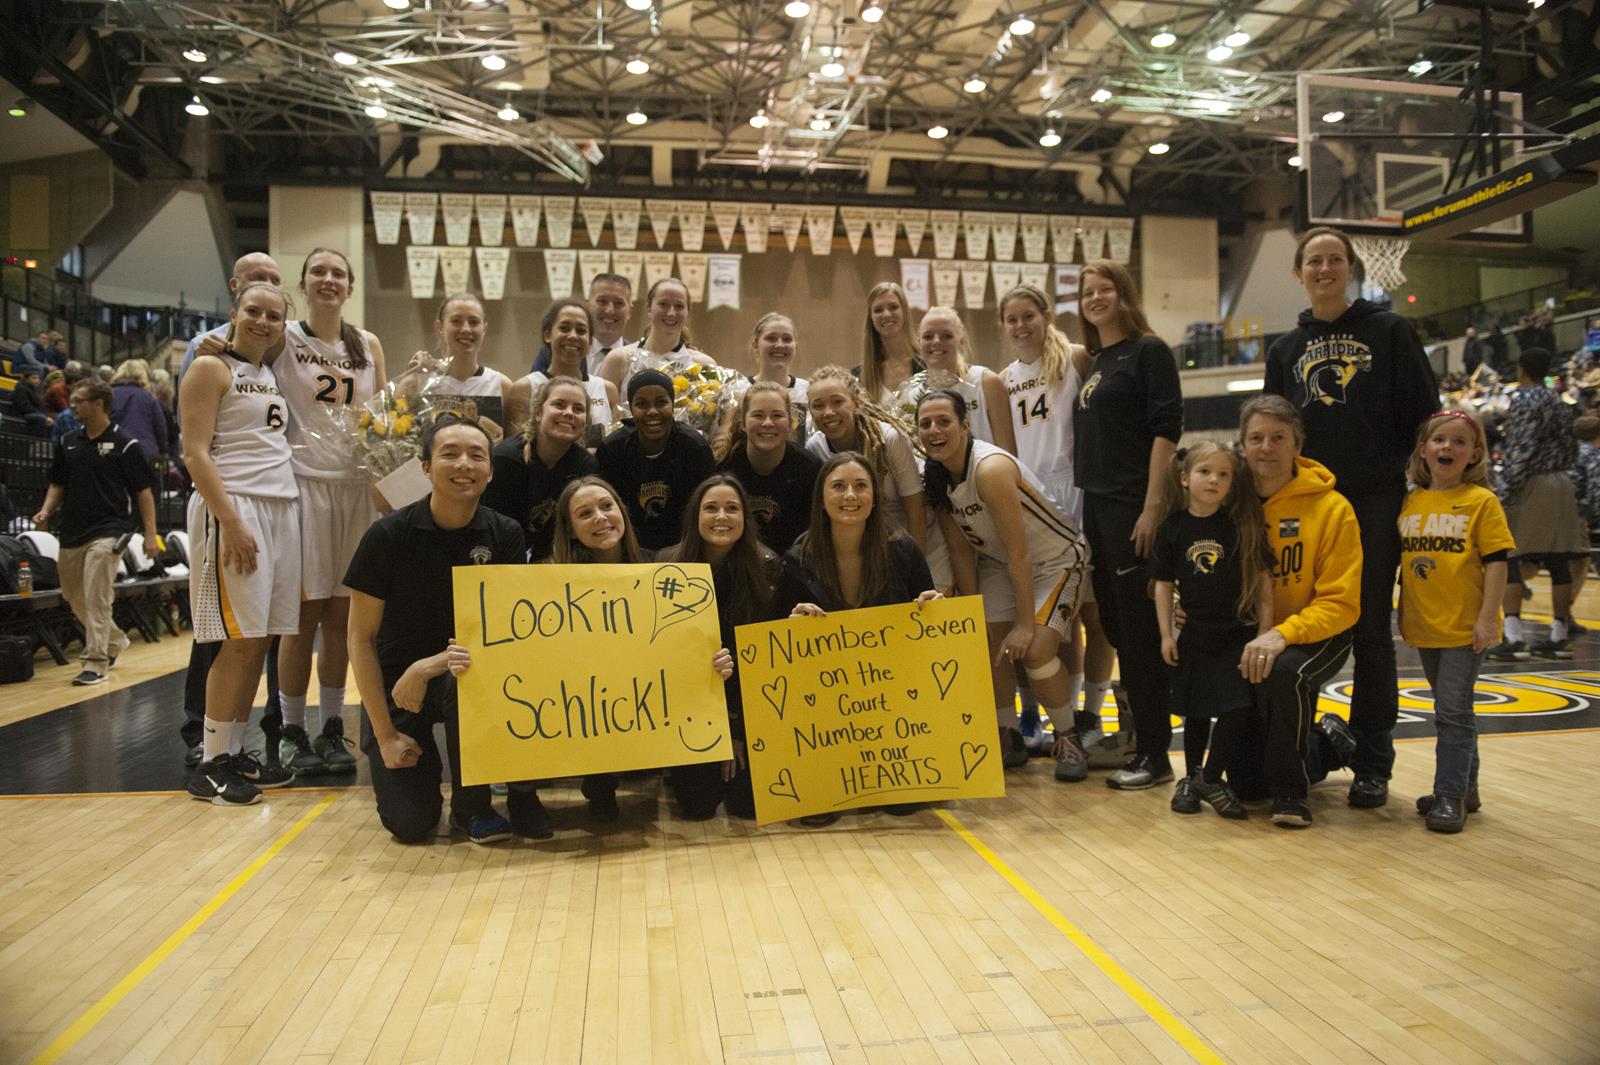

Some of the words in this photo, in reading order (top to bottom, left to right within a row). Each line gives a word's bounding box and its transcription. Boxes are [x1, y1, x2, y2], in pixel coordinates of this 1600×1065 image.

[1404, 172, 1534, 229] www.forumathletic.ca
[295, 353, 369, 371] WARIOR
[315, 374, 355, 405] 21
[266, 403, 284, 429] 6
[1017, 392, 1049, 426] 14
[1422, 513, 1471, 538] ARE
[1401, 535, 1466, 553] ARRIORS
[479, 578, 641, 647] Lookin'
[768, 624, 895, 668] Number
[905, 611, 976, 641] Seven
[819, 667, 849, 688] on
[856, 660, 895, 687] the
[502, 668, 671, 740] Schlick!
[837, 693, 891, 717] Court
[793, 721, 884, 757] Number
[895, 717, 931, 740] One
[859, 746, 876, 763] in
[881, 744, 910, 763] our
[839, 756, 942, 796] HEARTS
